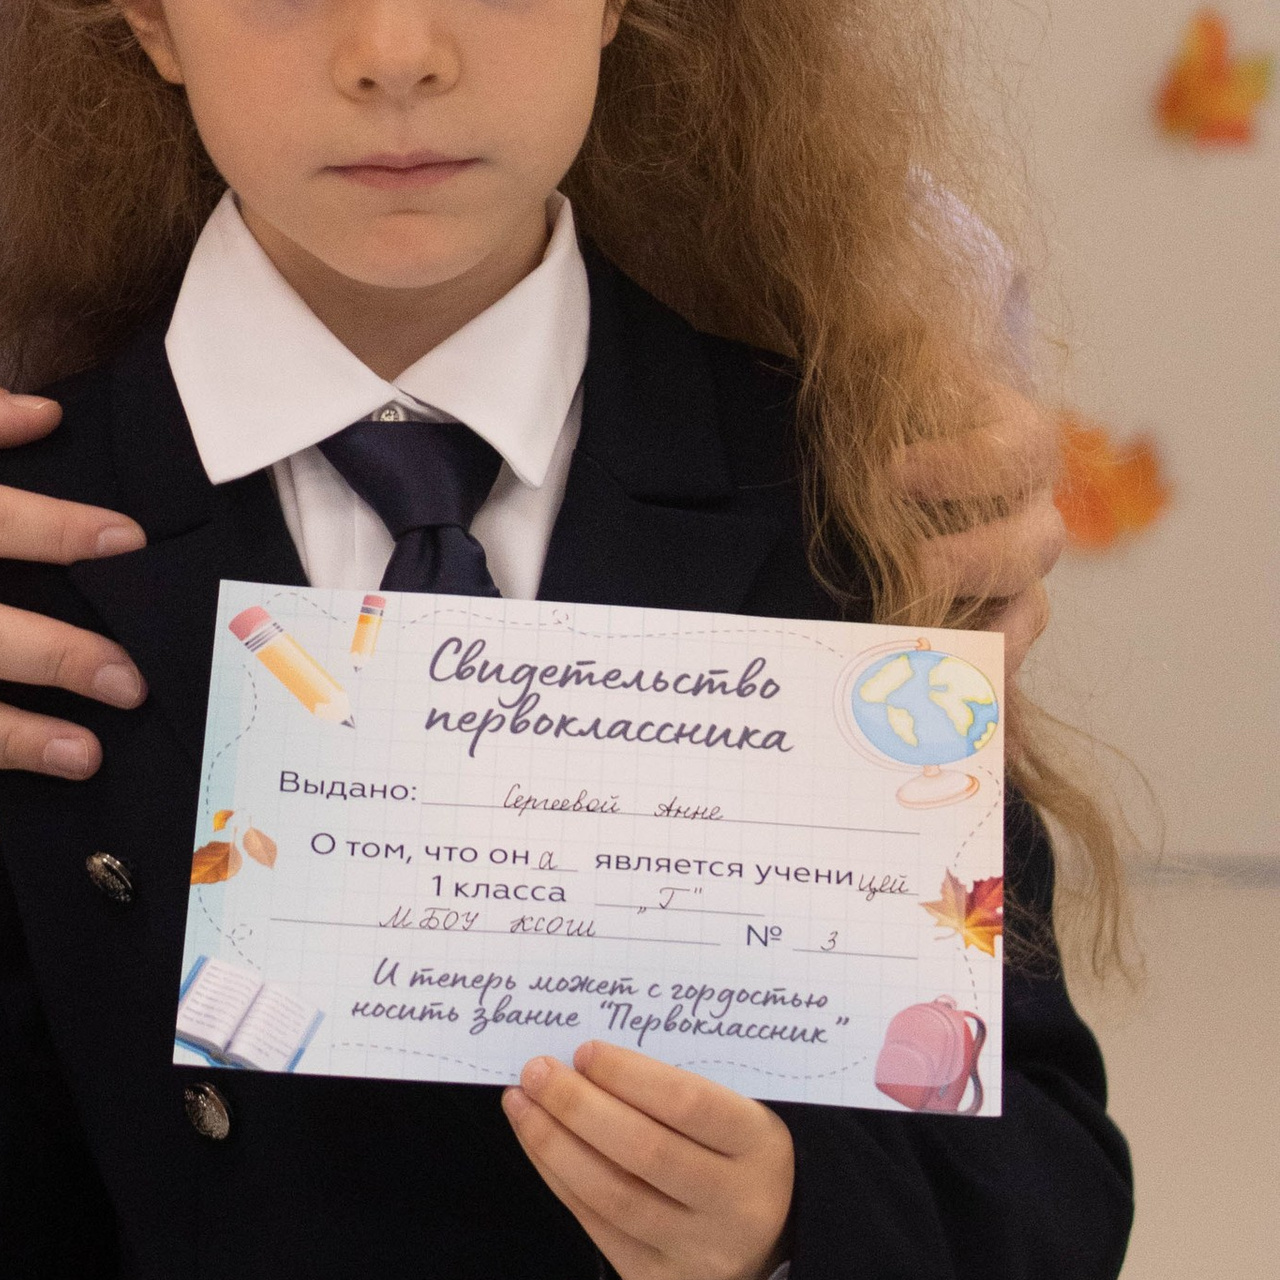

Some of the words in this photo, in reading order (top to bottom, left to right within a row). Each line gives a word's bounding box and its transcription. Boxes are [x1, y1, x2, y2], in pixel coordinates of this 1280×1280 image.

[429, 636, 781, 707] Свидетельство
[425, 692, 794, 758] первоклассника
[279, 771, 417, 802] Выдано:
[503, 783, 621, 816] Сергеевой
[654, 794, 724, 821] Анне
[310, 832, 336, 855] О
[346, 841, 412, 864] том,
[425, 845, 478, 863] что
[595, 854, 743, 878] является
[432, 875, 442, 897] 1
[454, 882, 567, 903] класса
[746, 924, 783, 947] №
[820, 931, 839, 952] 3
[373, 957, 400, 987] И
[409, 967, 517, 1006] теперь
[528, 975, 638, 996] может
[647, 983, 662, 998] с
[671, 983, 828, 1019] гордостью
[351, 1001, 460, 1023] носить
[469, 993, 581, 1036] звание
